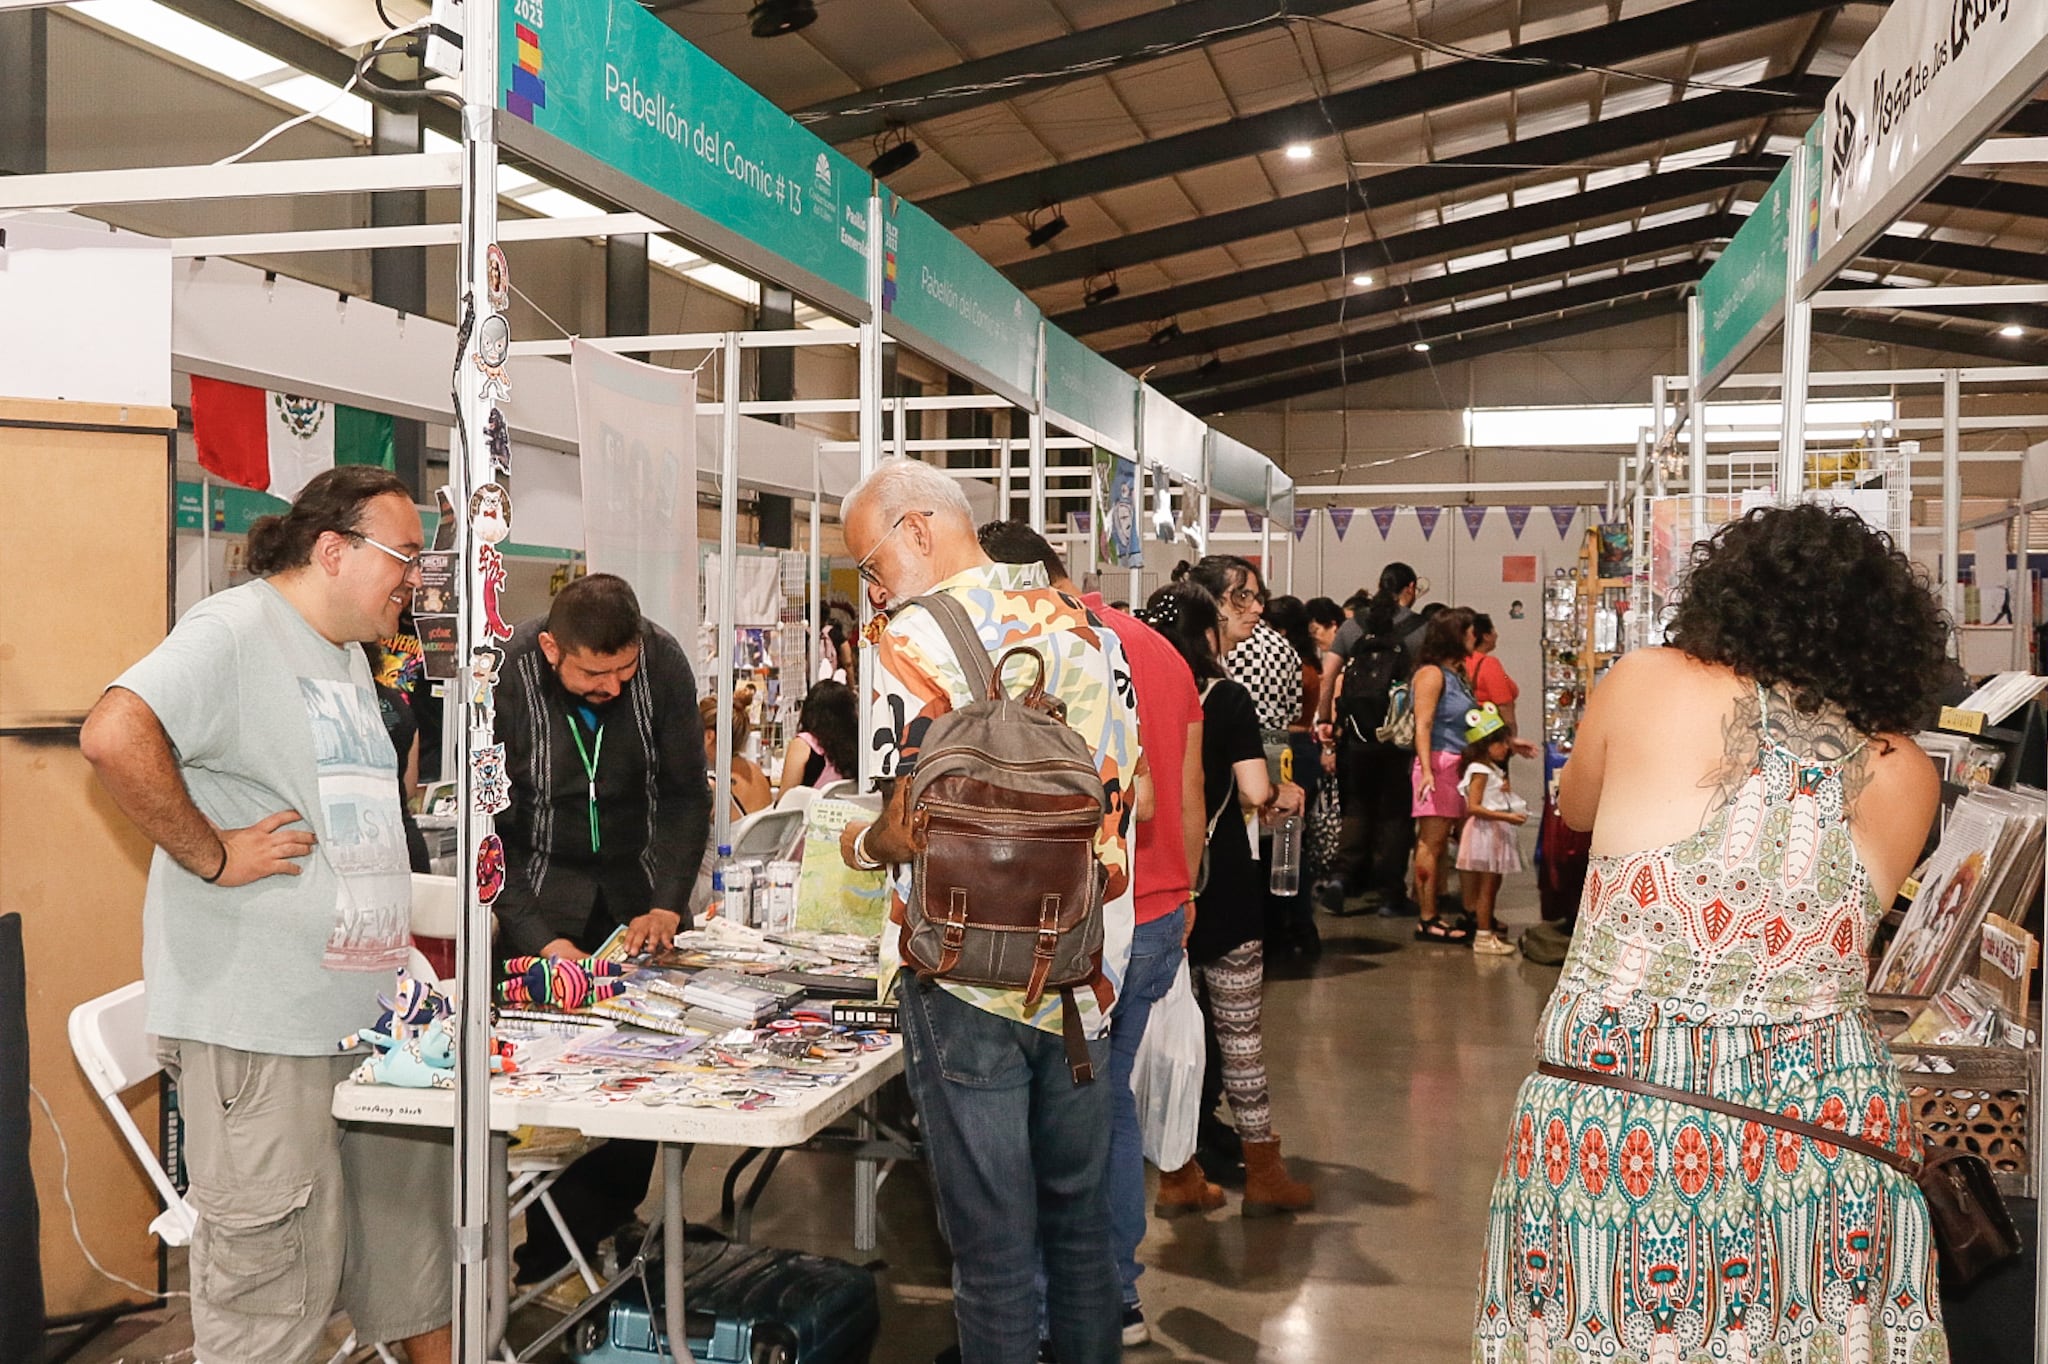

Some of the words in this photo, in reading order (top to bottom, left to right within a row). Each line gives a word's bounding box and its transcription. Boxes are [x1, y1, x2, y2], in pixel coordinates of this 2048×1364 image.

[513, 0, 544, 29] 2023
[605, 62, 689, 149] Pabellón
[693, 121, 720, 167] del
[723, 140, 774, 198] Comic
